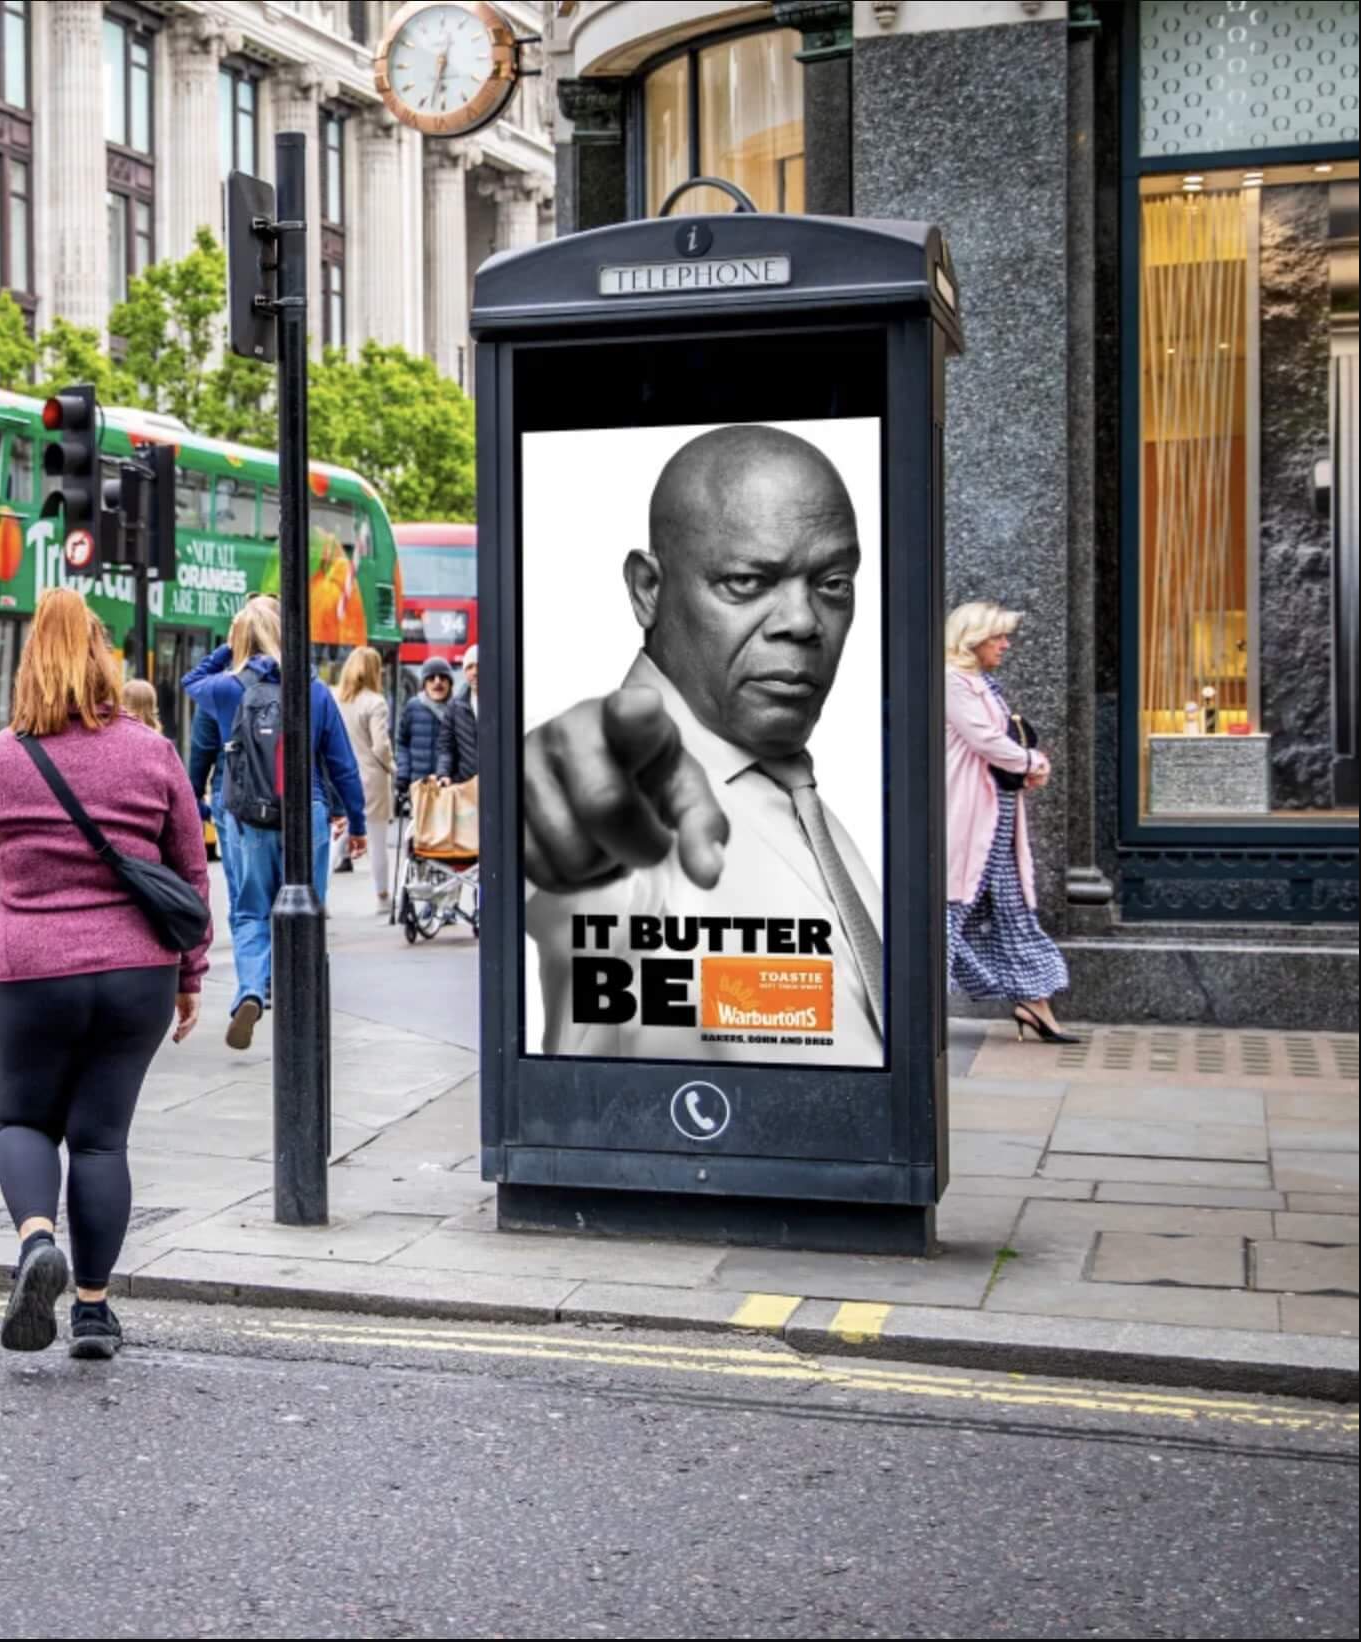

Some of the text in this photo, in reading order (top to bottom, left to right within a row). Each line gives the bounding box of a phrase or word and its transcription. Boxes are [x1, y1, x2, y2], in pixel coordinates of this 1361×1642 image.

[614, 260, 777, 292] TELEPHONE
[192, 539, 216, 565] NOT
[177, 562, 248, 593] ORANGES
[197, 591, 219, 616] THE
[221, 594, 247, 618] SAM
[440, 613, 466, 634] 94
[572, 914, 834, 956] IT BUTTER
[758, 971, 824, 984] TOASTIE
[572, 956, 698, 1028] BE
[780, 1036, 803, 1046] AND
